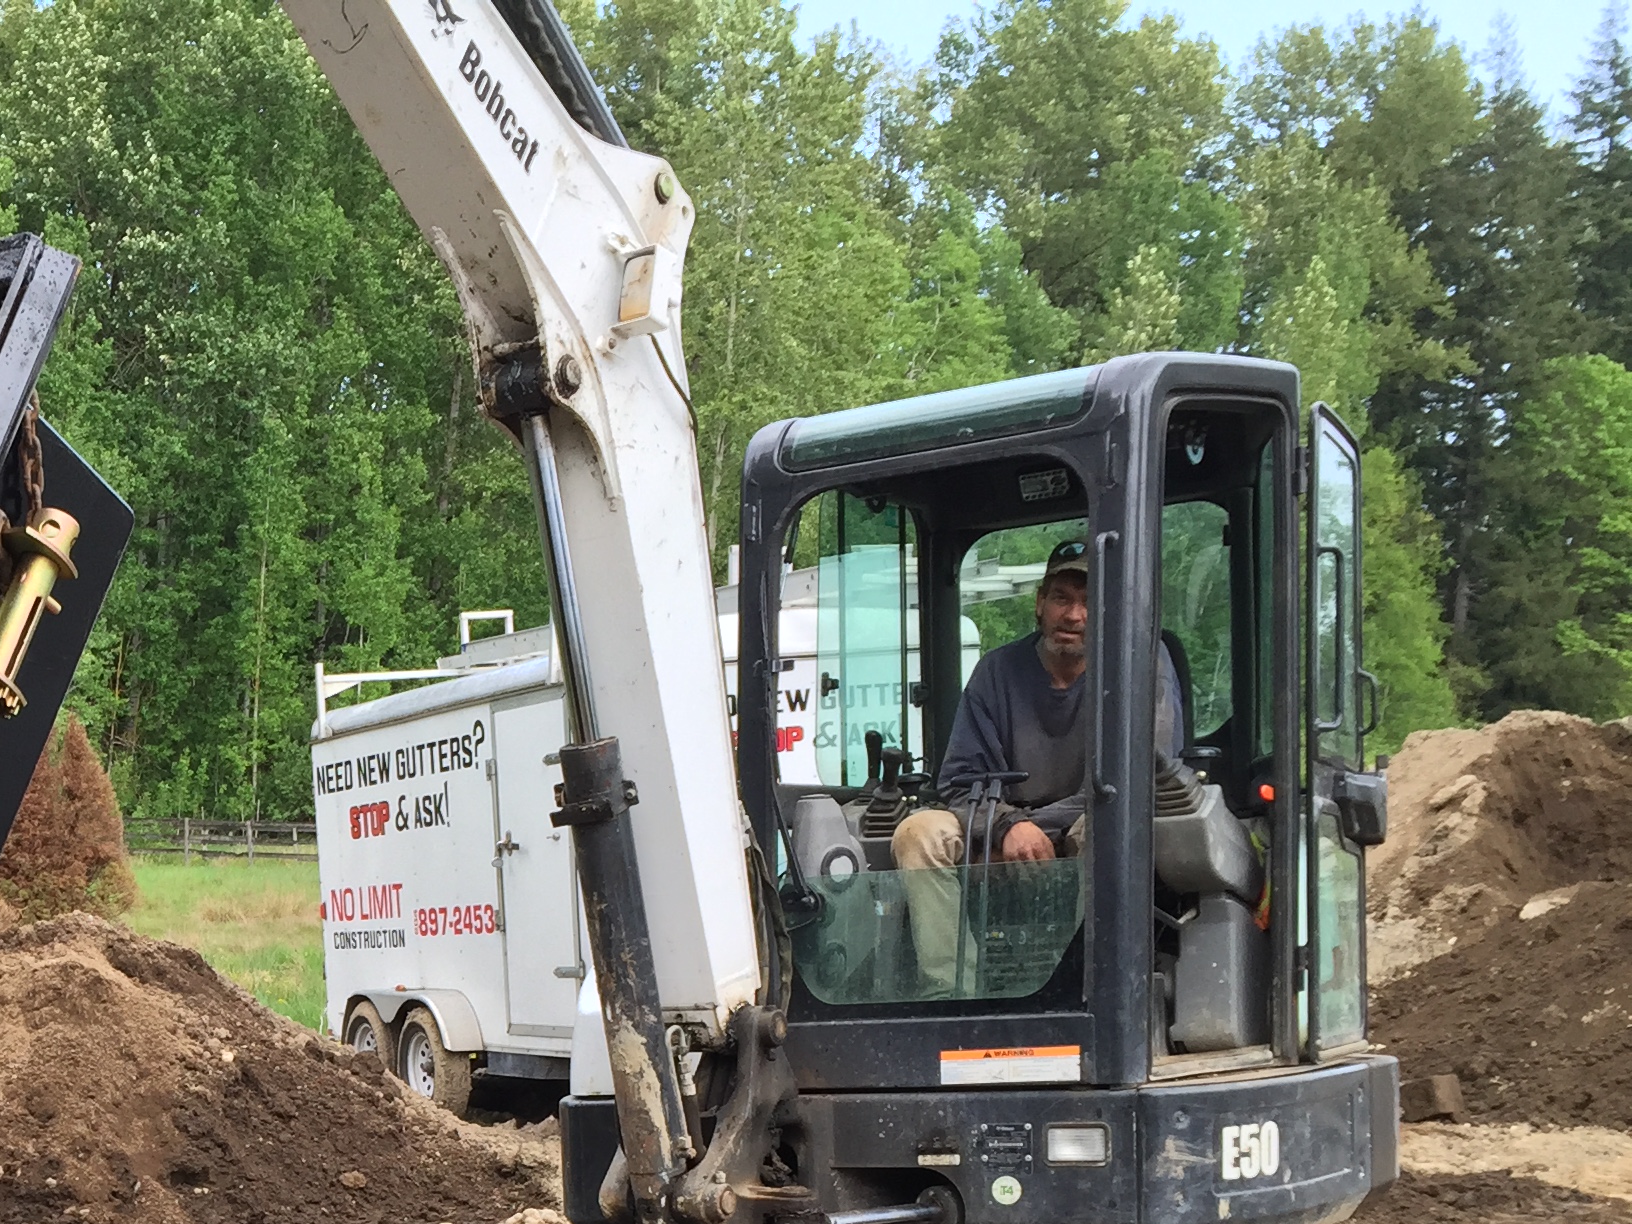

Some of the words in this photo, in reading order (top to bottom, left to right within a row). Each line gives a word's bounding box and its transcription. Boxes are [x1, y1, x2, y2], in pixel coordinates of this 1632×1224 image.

[458, 38, 540, 175] Bobcat
[316, 760, 353, 796] NEED
[357, 751, 390, 788] NEW
[395, 720, 485, 781] GUTTERS?
[349, 801, 390, 839] STOP
[395, 795, 409, 832] &
[414, 780, 450, 829] ASK!
[330, 888, 354, 922] NO
[359, 884, 402, 920] LIMIT
[418, 904, 495, 936] 897-2453
[333, 929, 406, 949] CONSTRUCTION
[994, 1049, 1035, 1057] WARNING
[1222, 1120, 1280, 1180] E50
